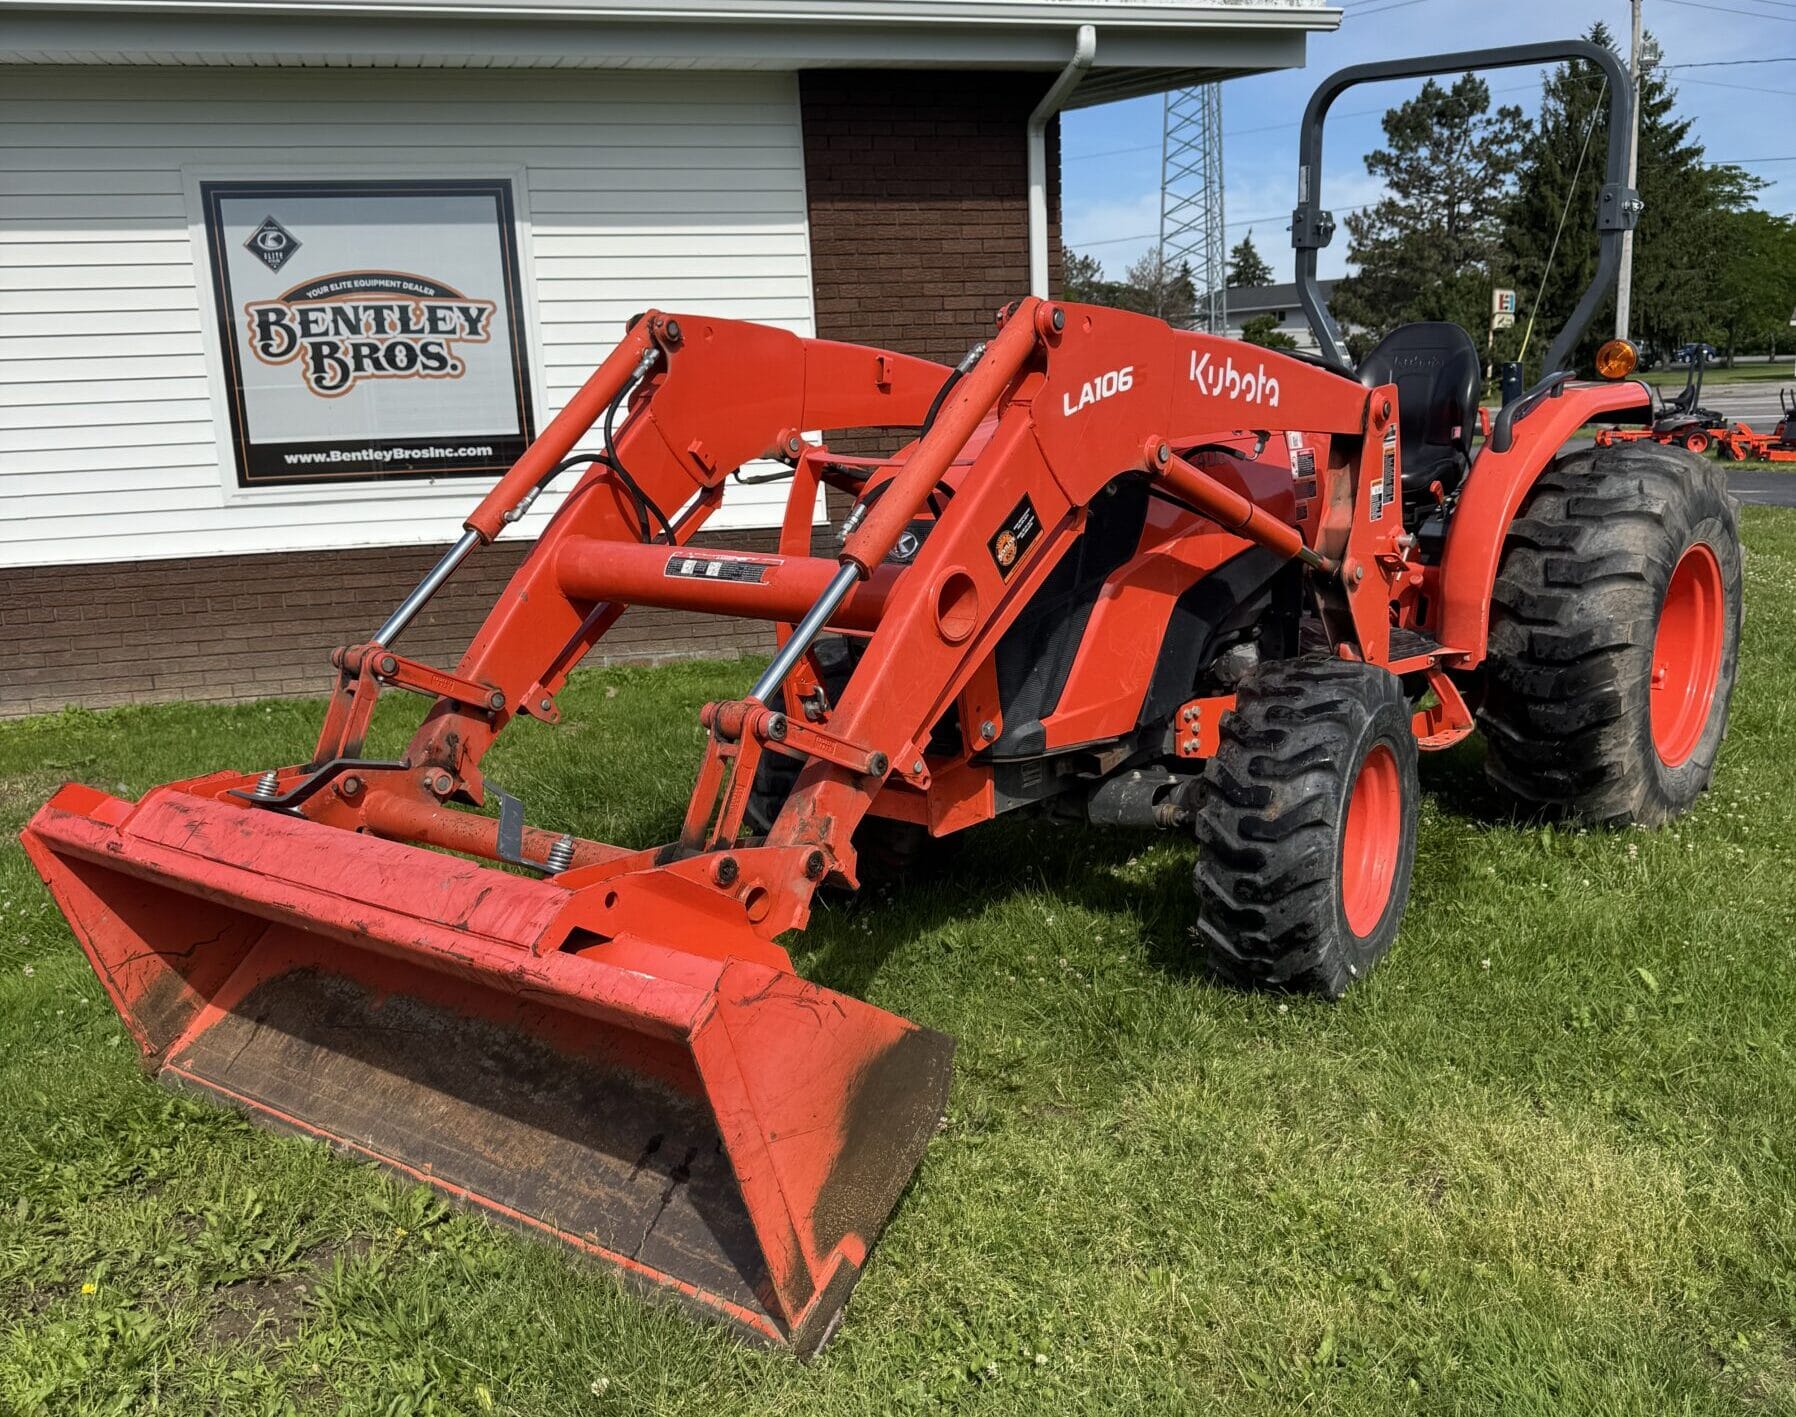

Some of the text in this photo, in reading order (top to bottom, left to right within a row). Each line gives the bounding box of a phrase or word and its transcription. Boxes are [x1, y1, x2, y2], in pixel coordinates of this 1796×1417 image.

[306, 279, 435, 299] YOUR ELITE EQUIPMENT DEALER
[254, 305, 488, 357] BENTLEY
[309, 338, 459, 391] BROS.
[1188, 350, 1280, 408] Kubota
[284, 446, 493, 464] www.BentleyBrosInc.com
